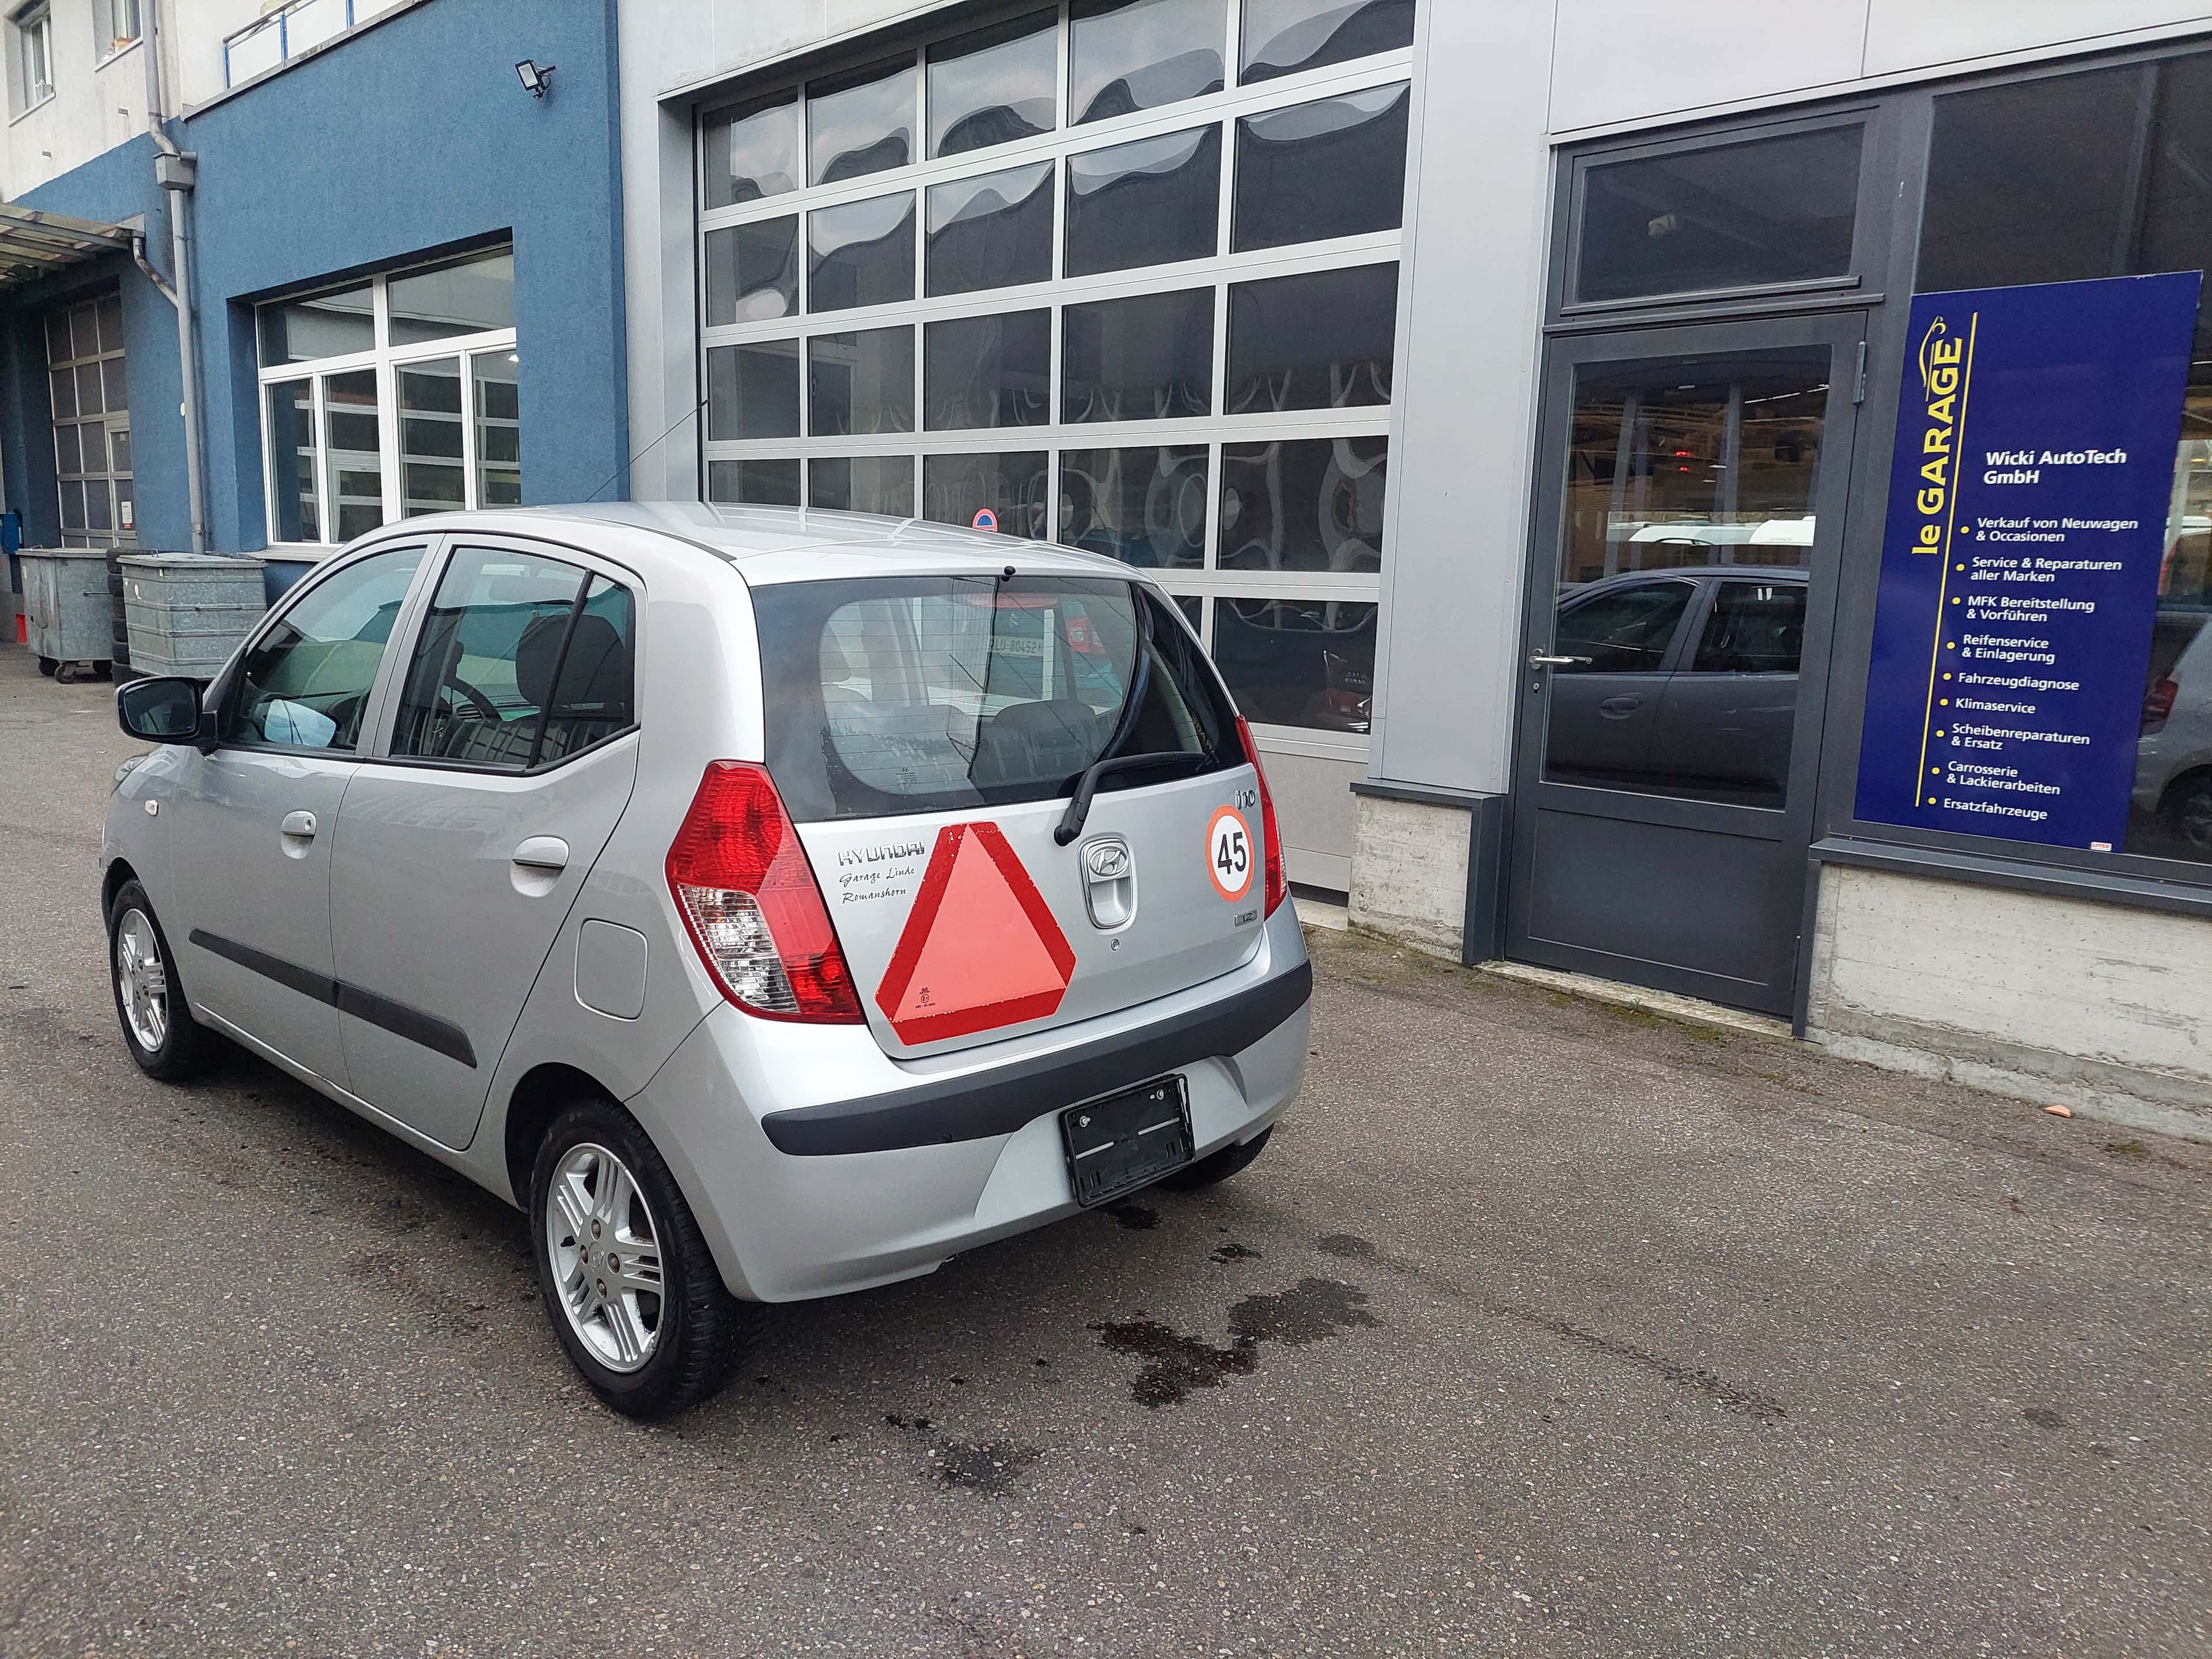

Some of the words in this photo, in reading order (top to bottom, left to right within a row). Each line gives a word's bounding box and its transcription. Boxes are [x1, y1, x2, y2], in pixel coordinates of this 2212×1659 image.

[1916, 337, 1963, 515] GARAGE
[1986, 450, 2035, 466] Wicki
[2037, 448, 2127, 465] AutoTech
[1983, 469, 2040, 484] GmbH
[1977, 517, 2031, 528] Verkauf
[2032, 520, 2058, 529] von
[2061, 517, 2139, 532] Neuwagen
[1911, 524, 1941, 555] le
[1976, 530, 1986, 541] &
[1989, 530, 2065, 542] Occasionen
[1972, 556, 2018, 568] Service
[2021, 557, 2032, 569] &
[2035, 558, 2122, 571] Reparaturen
[1970, 569, 2001, 581] aller
[2002, 570, 2055, 582] Marken
[1967, 595, 1998, 607] MFK
[2000, 596, 2095, 613] Bereitstellung
[1966, 608, 1976, 619] &
[1979, 609, 2047, 622] Vorführen
[1963, 634, 2049, 649] Reifenservice
[1961, 647, 1972, 658] &
[1975, 647, 2055, 665] Einlagerung
[1958, 672, 2080, 691] Fahrzeugdiagnose
[1955, 698, 2036, 714] Klimaservice
[1951, 736, 1961, 747] &
[1964, 737, 2003, 750] Ersatz
[1952, 724, 2090, 745] Scheibenreparaturen
[1948, 760, 2018, 778] Carrosserie
[1946, 773, 1956, 784] &
[1959, 774, 2061, 795] Lackierarbeiten
[1234, 789, 1256, 810] i10
[1944, 798, 2048, 821] Ersatzfahrzeuge
[838, 840, 925, 866] HYUNDAI
[1217, 831, 1247, 875] 45
[839, 872, 881, 888] Garage
[886, 865, 915, 880] Linde
[842, 887, 907, 904] Romanshorn
